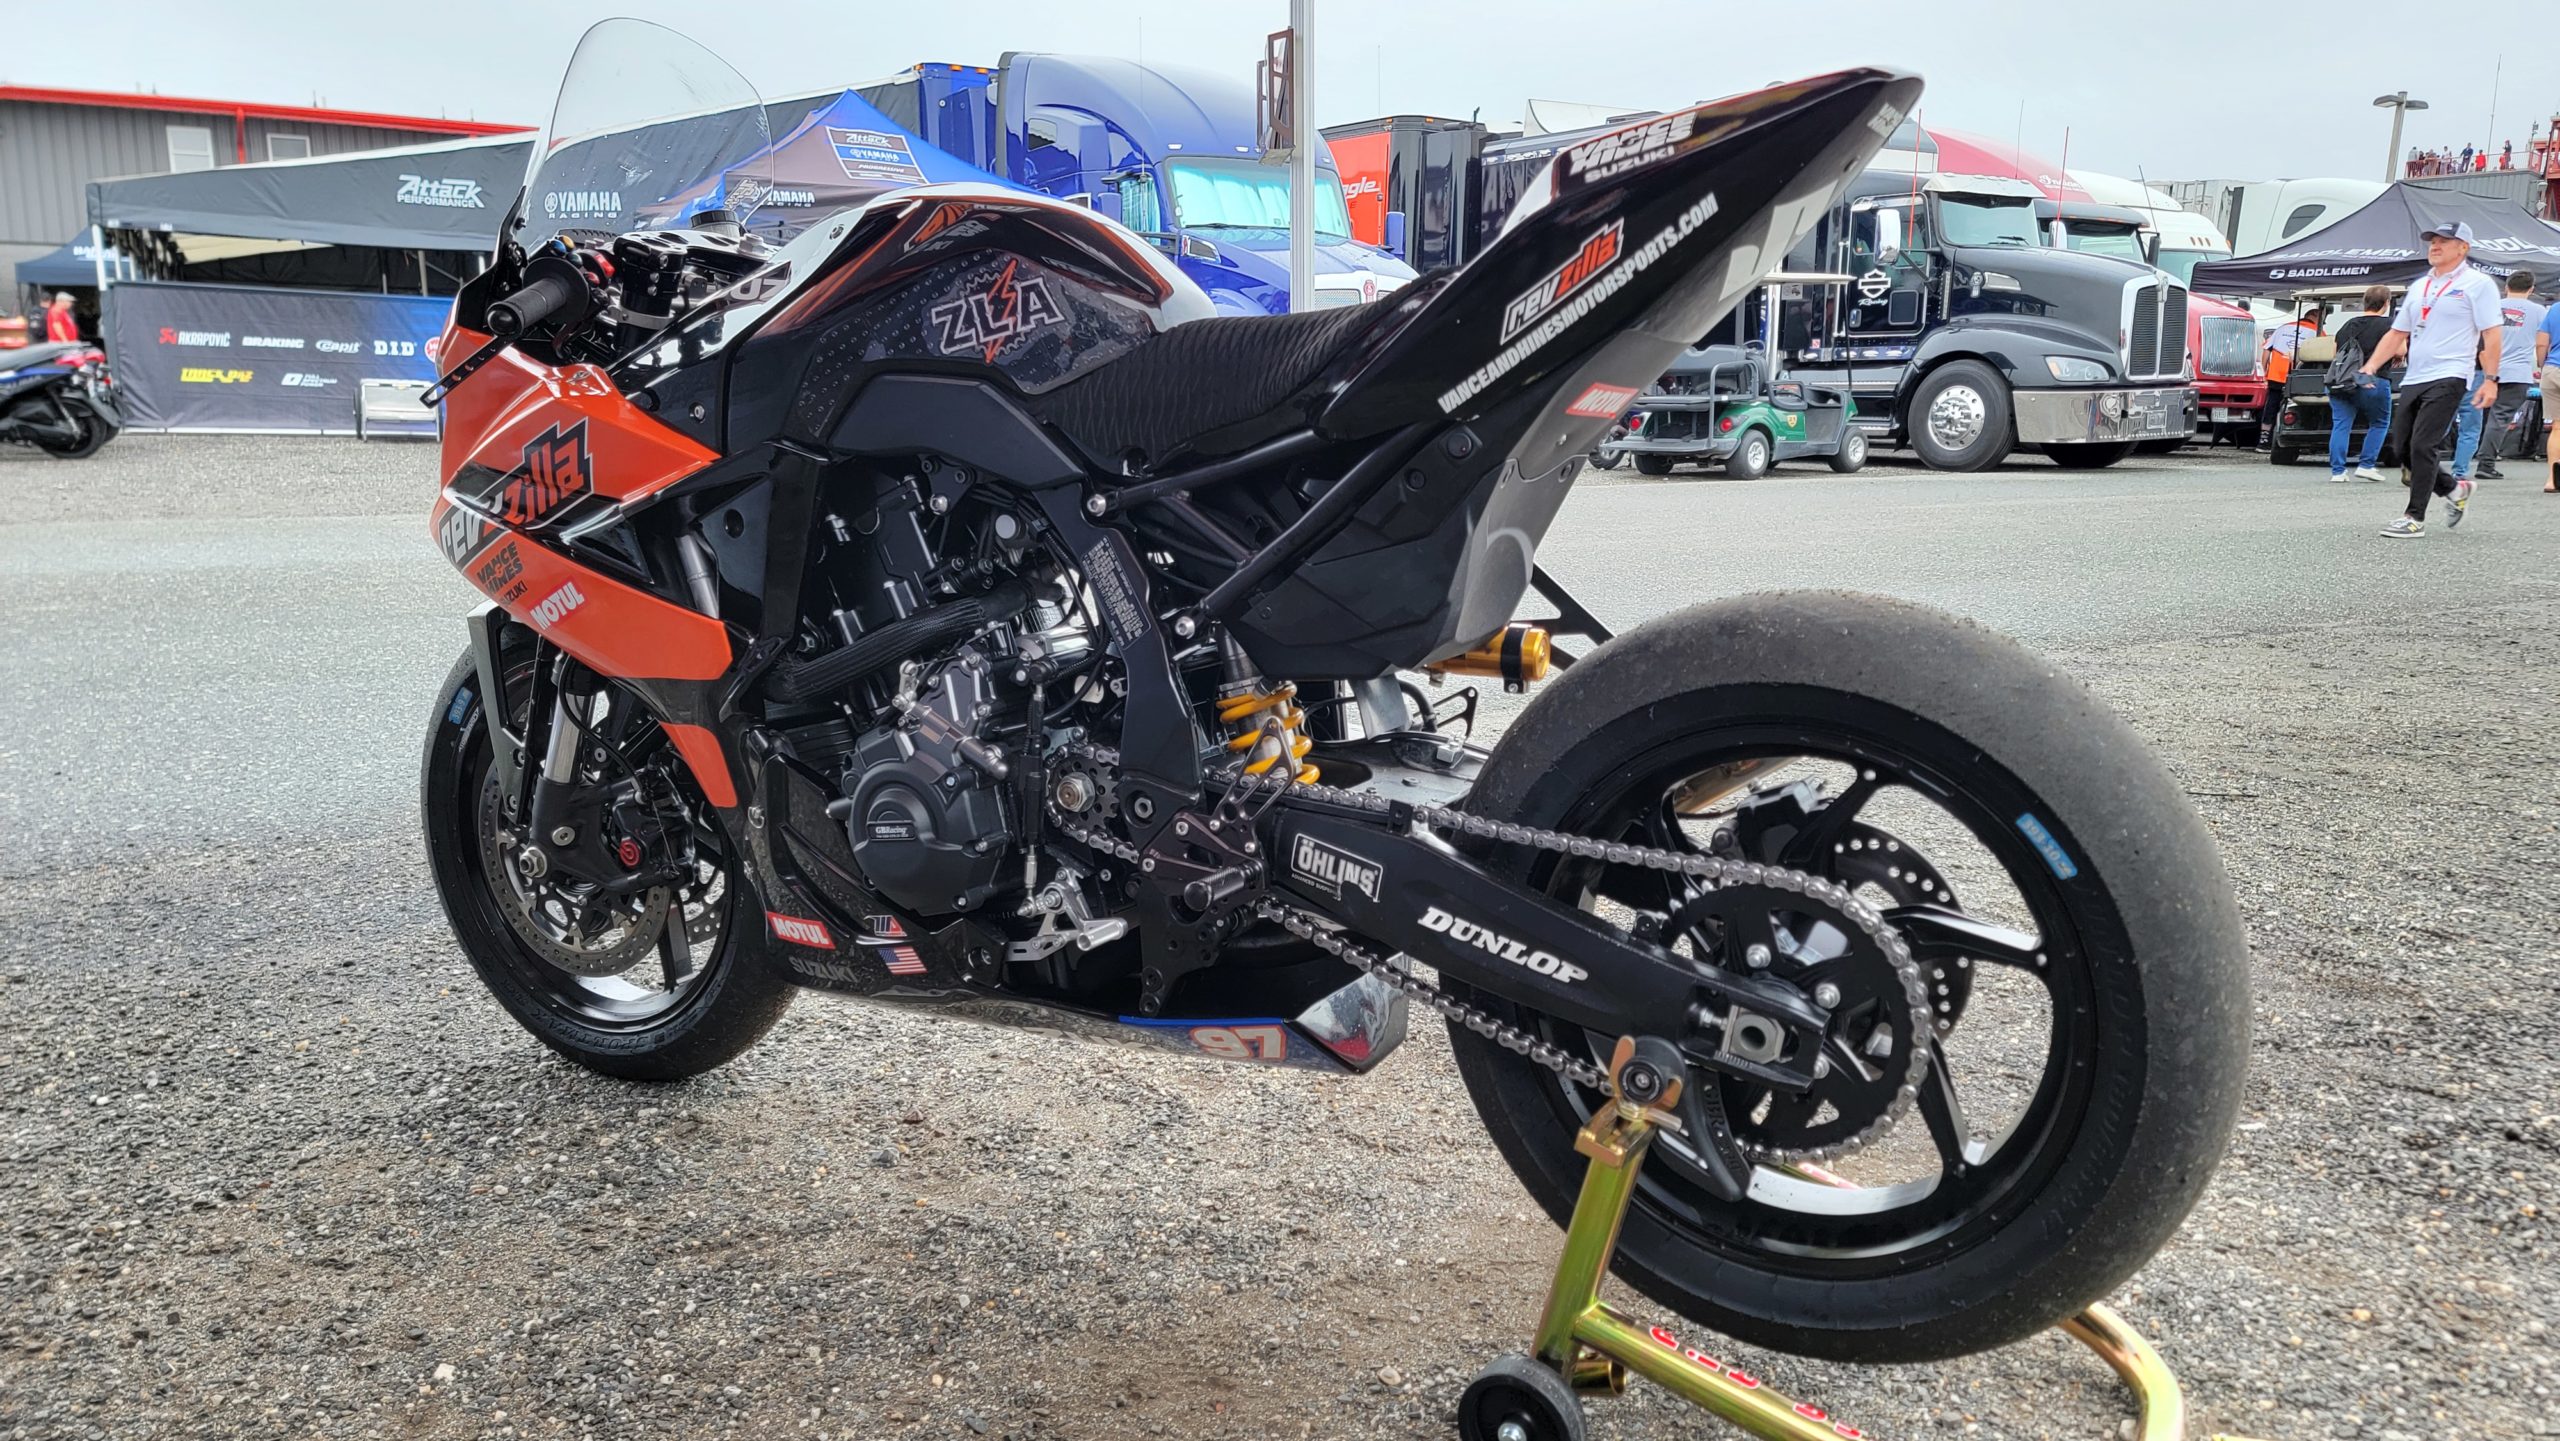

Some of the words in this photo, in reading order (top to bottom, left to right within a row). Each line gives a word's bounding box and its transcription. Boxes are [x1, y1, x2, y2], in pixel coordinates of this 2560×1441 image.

[1569, 124, 1694, 176] HINES
[1570, 111, 1698, 162] VANCE
[860, 149, 900, 162] YAMAHA
[1584, 144, 1676, 184] SUZUKI
[397, 174, 485, 208] Attack
[397, 194, 475, 208] PERFORMANCE
[558, 191, 622, 212] YAMAHA
[2268, 249, 2411, 260] SADDLEMEN
[1506, 226, 1618, 334] revzilla
[2287, 267, 2369, 278] SADDLEMEN
[1437, 191, 1719, 414] VANCEANDHINESMOTORSPORTS.COM
[242, 336, 304, 348] BRAKING
[374, 340, 415, 356] D.I.D
[476, 541, 519, 585] VANCE
[484, 557, 525, 595] HINES
[529, 581, 585, 631] MOTUL
[1297, 838, 1376, 898] ÖHLINS
[771, 917, 830, 945] MOTUL
[1417, 906, 1589, 984] DUNLOP
[788, 955, 859, 983] SUZUKI
[1192, 1026, 1288, 1060] 97
